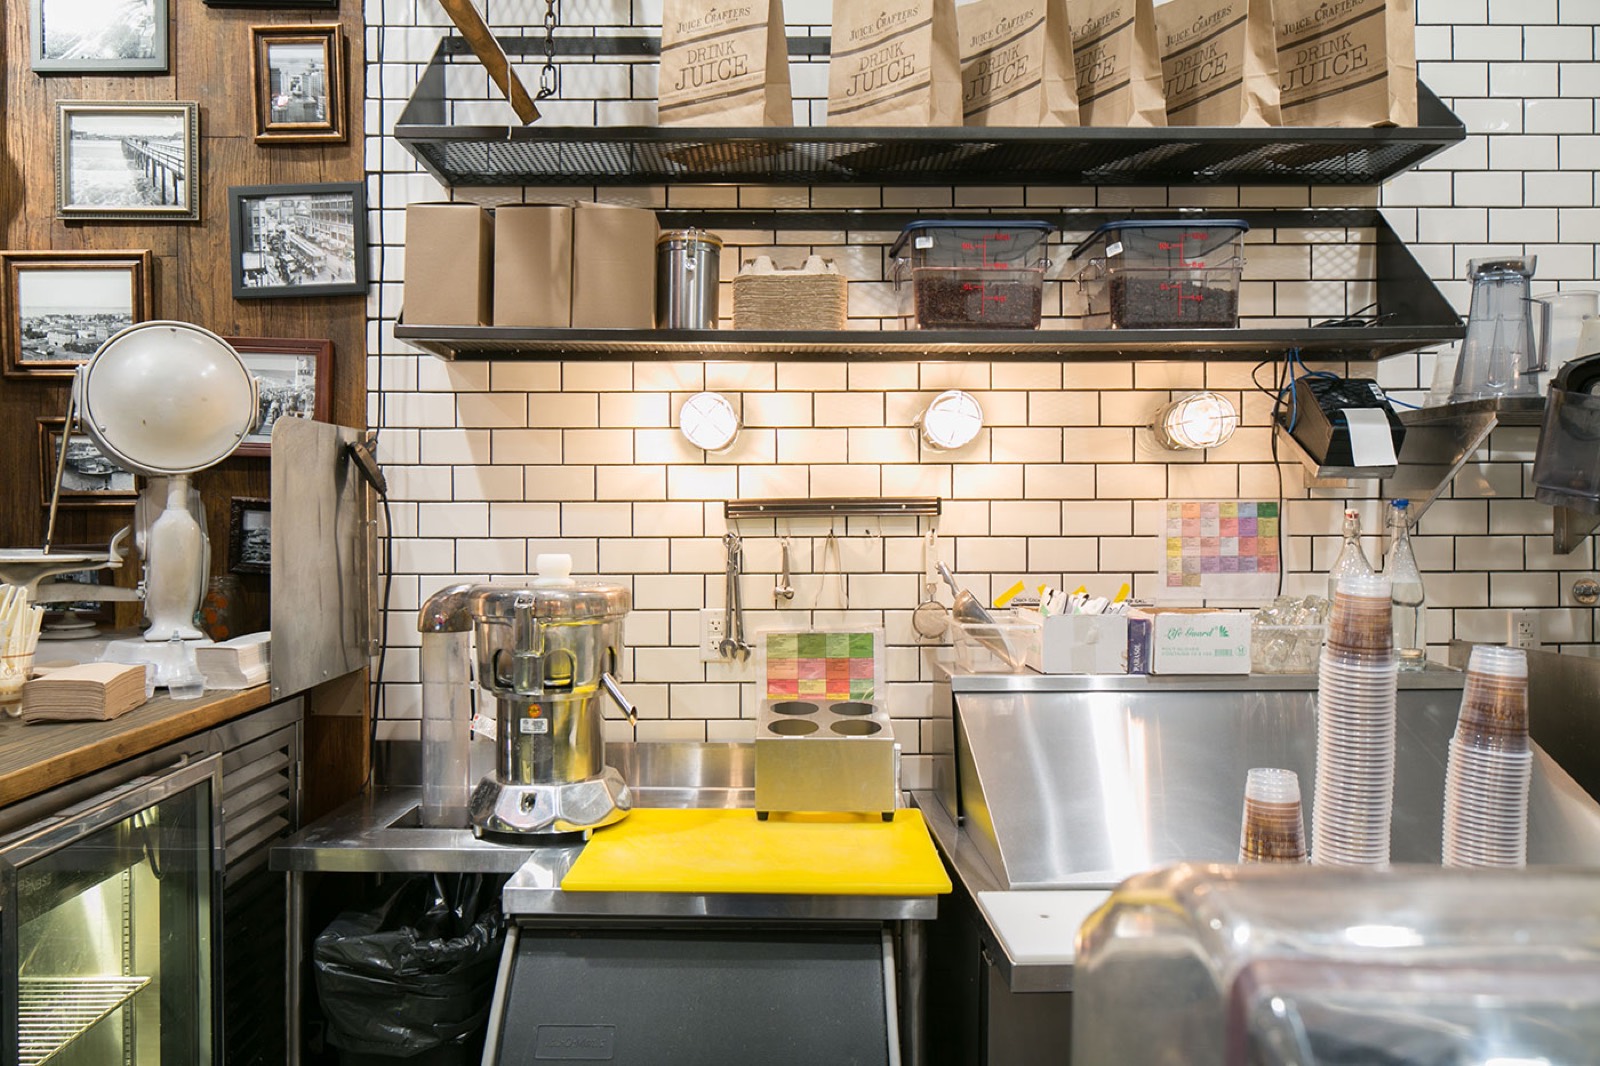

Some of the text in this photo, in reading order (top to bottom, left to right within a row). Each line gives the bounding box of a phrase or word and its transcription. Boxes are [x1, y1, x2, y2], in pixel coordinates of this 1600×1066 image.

[676, 7, 751, 34] JUICE CRAFTERS
[849, 7, 918, 41] JUICE CRAFTERS
[1081, 8, 1121, 35] CRAFTERS
[1165, 7, 1232, 48] JUICE CRAFTERS
[1282, 16, 1311, 36] JUICE
[687, 40, 736, 65] DRINK
[970, 30, 994, 48] JUICE
[1296, 32, 1352, 66] DRINK
[675, 54, 748, 91] JUICE
[858, 41, 905, 72] DRINK
[978, 44, 1020, 76] DRINK
[1075, 45, 1107, 69] RINK
[1076, 54, 1116, 91] ICE
[1174, 41, 1218, 76] DRINK
[1281, 44, 1368, 92] JUICE
[846, 54, 915, 97] JUICE
[965, 55, 1029, 101] JUICE
[1163, 53, 1228, 98] JUICE
